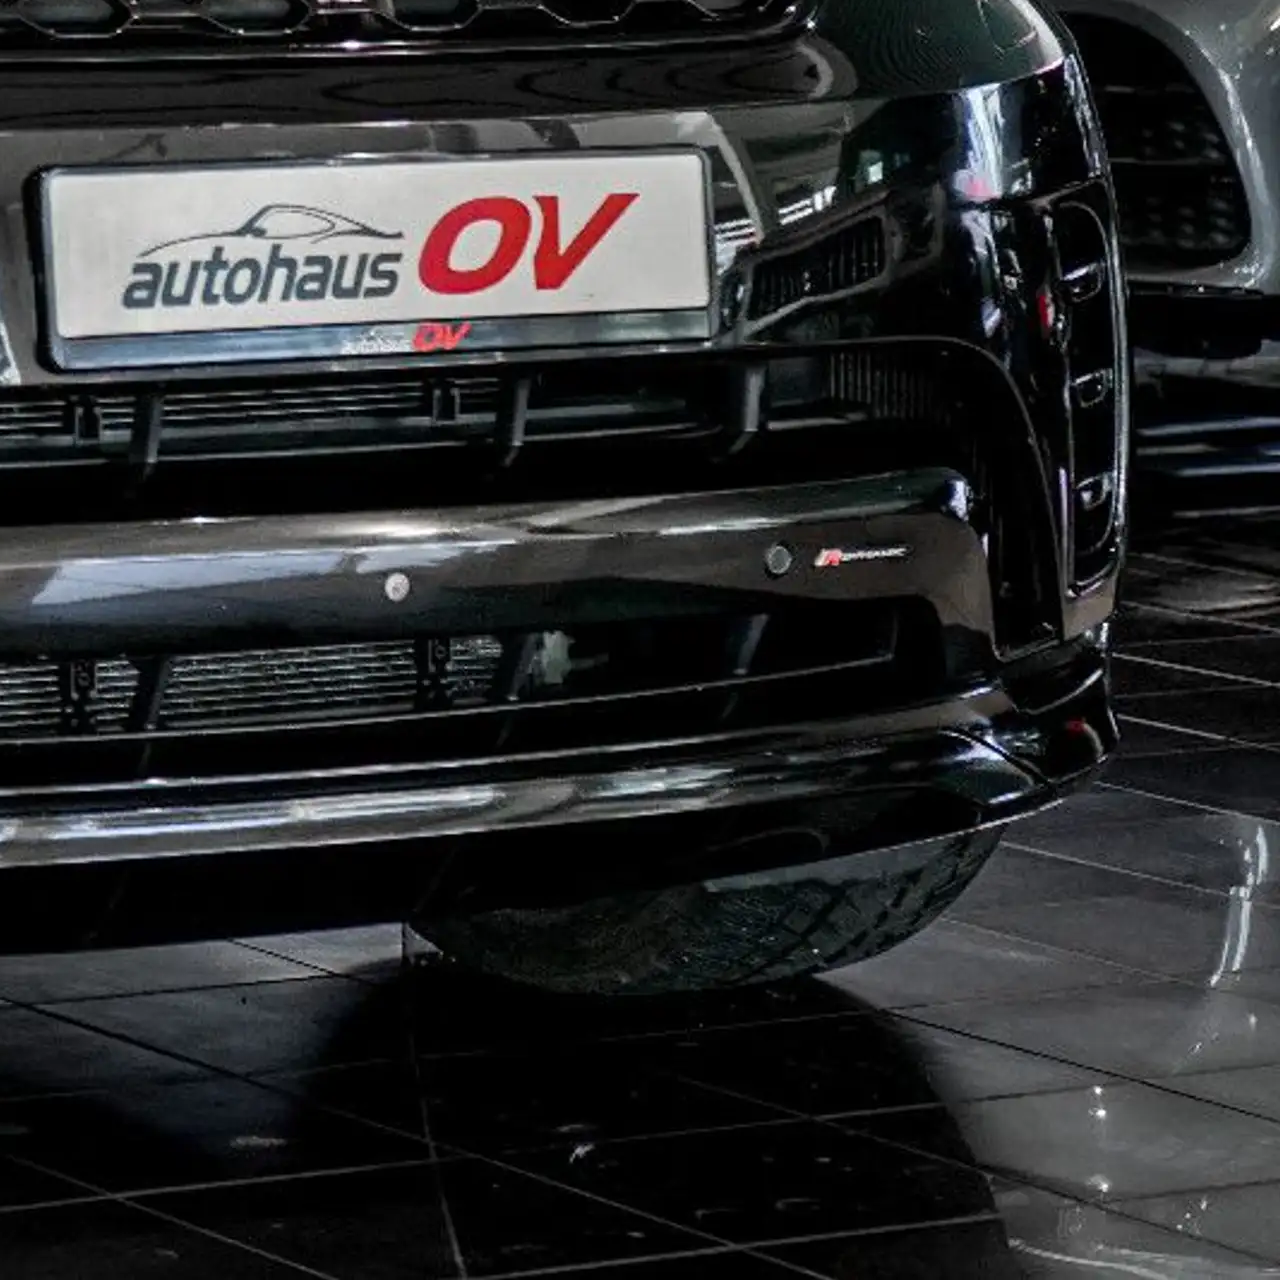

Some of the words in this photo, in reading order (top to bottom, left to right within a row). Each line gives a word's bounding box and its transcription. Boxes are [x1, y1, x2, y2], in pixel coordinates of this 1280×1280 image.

[122, 243, 404, 310] autohaus
[416, 192, 641, 296] OV
[411, 320, 472, 352] OV
